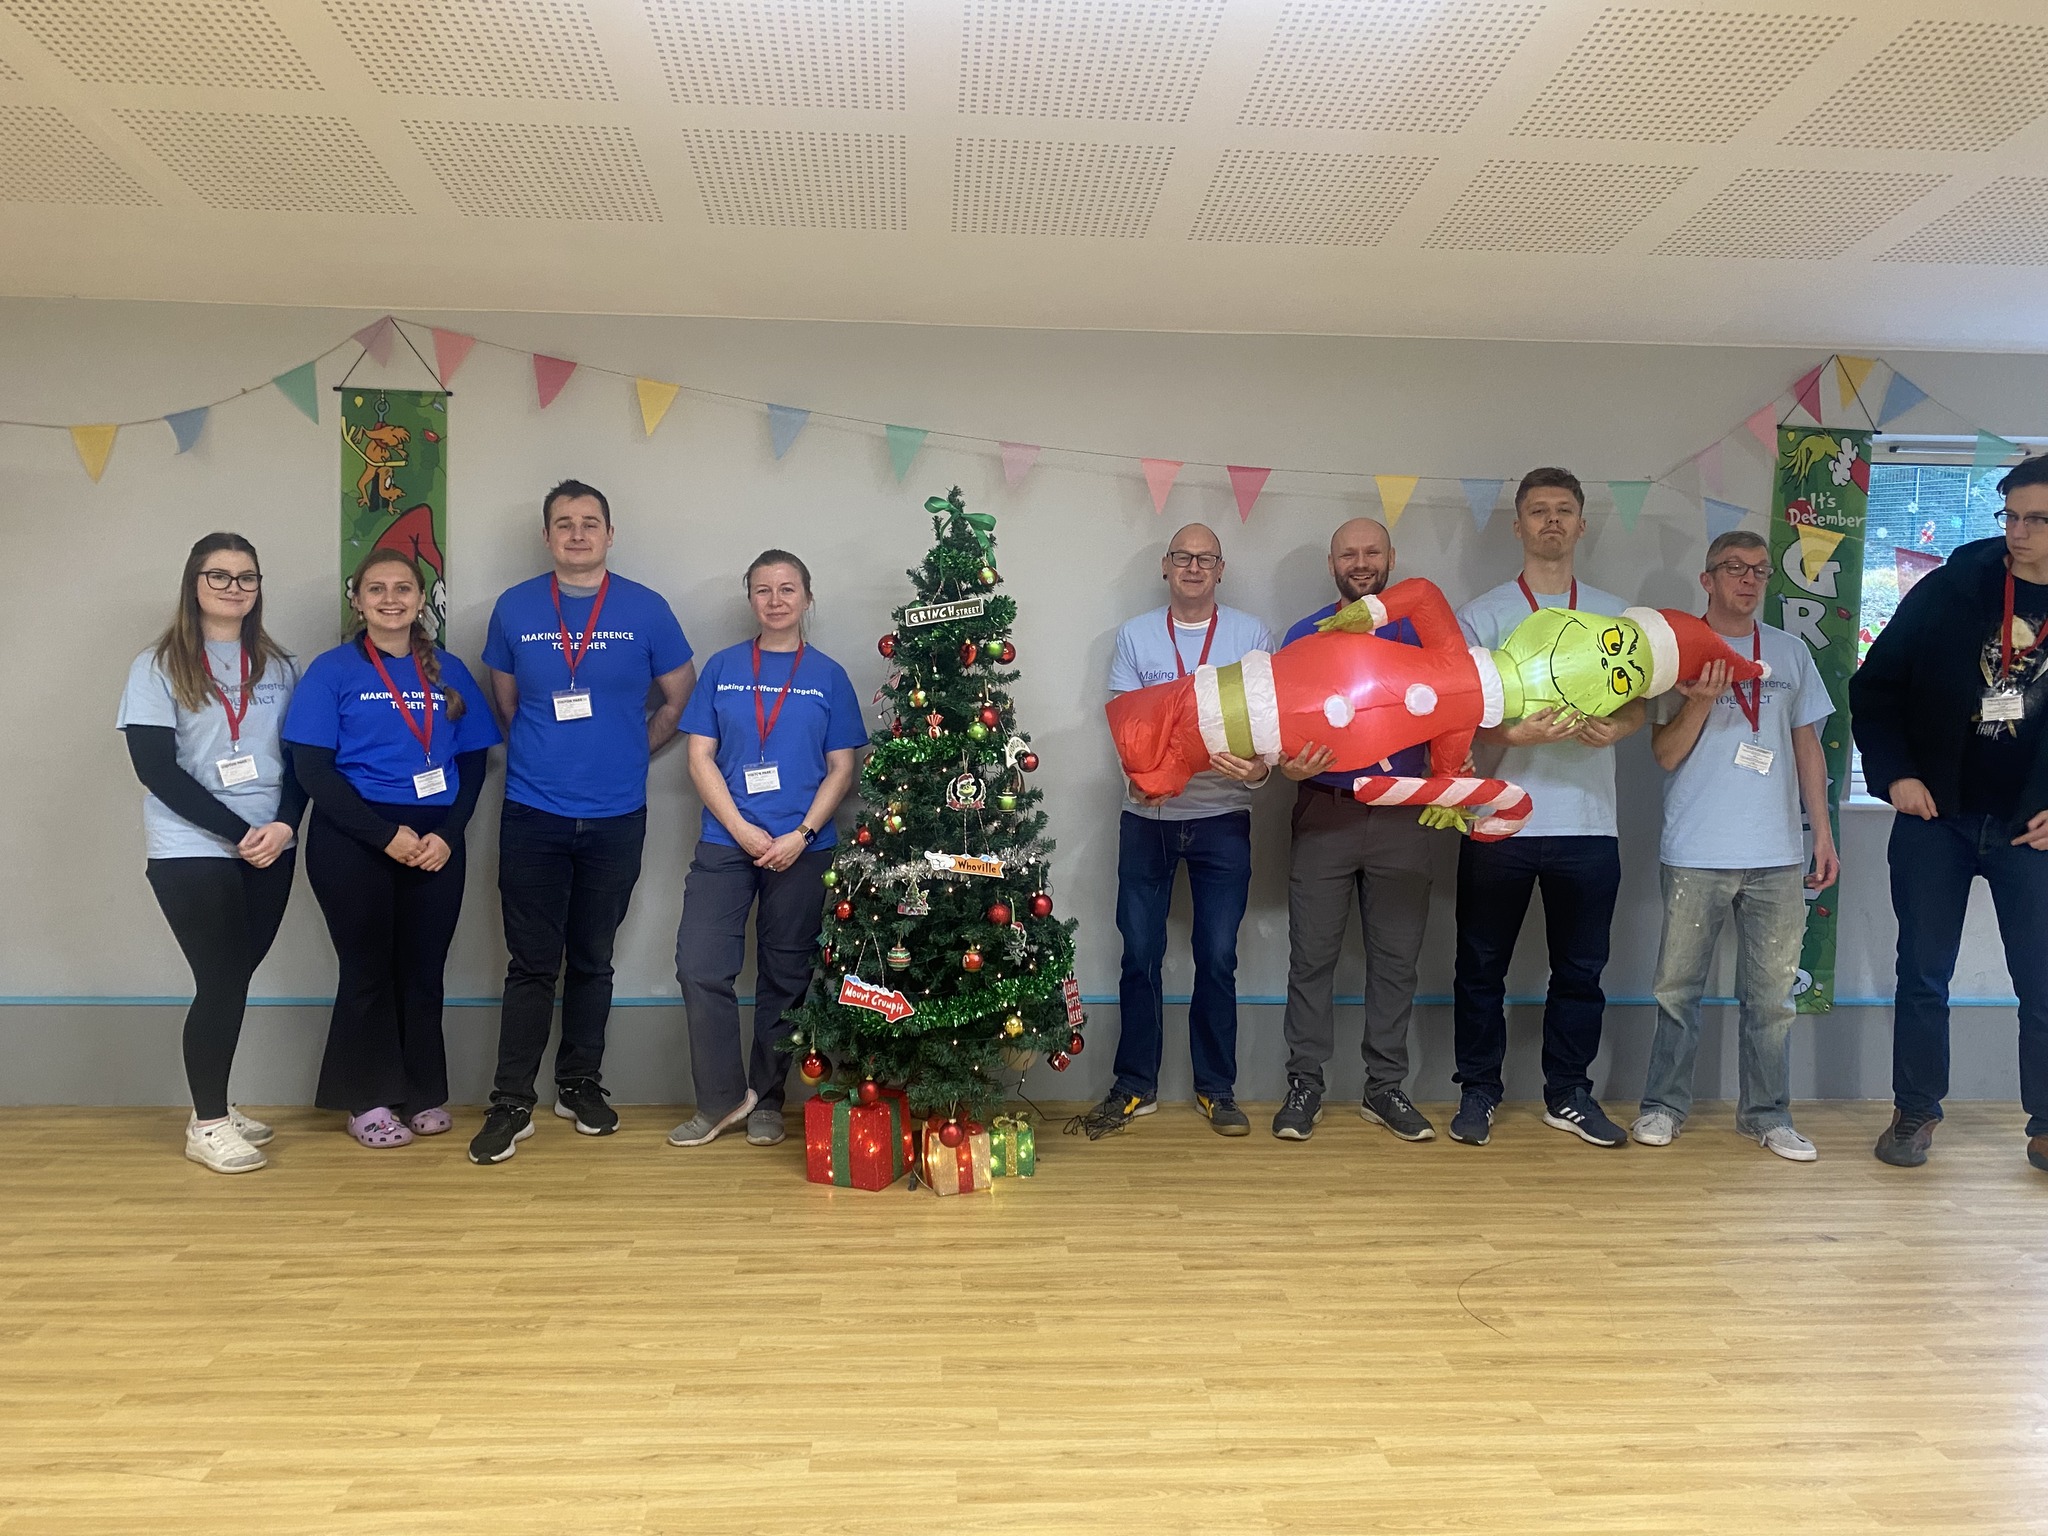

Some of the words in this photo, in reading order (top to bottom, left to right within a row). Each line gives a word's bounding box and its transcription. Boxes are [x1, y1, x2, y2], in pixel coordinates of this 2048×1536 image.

[1810, 492, 1836, 509] It's
[910, 605, 955, 623] GRINCH
[955, 605, 980, 616] STREET
[521, 632, 562, 642] MAKING
[576, 631, 635, 641] DFERENCE
[1139, 669, 1174, 681] Making
[717, 683, 744, 692] Making
[1740, 679, 1792, 690] diference
[360, 691, 393, 701] MAKIN
[402, 691, 410, 699] A
[390, 701, 439, 711] TGETHR
[957, 860, 997, 873] Whoville
[845, 986, 870, 1003] Mount
[871, 994, 904, 1014] Crumpit
